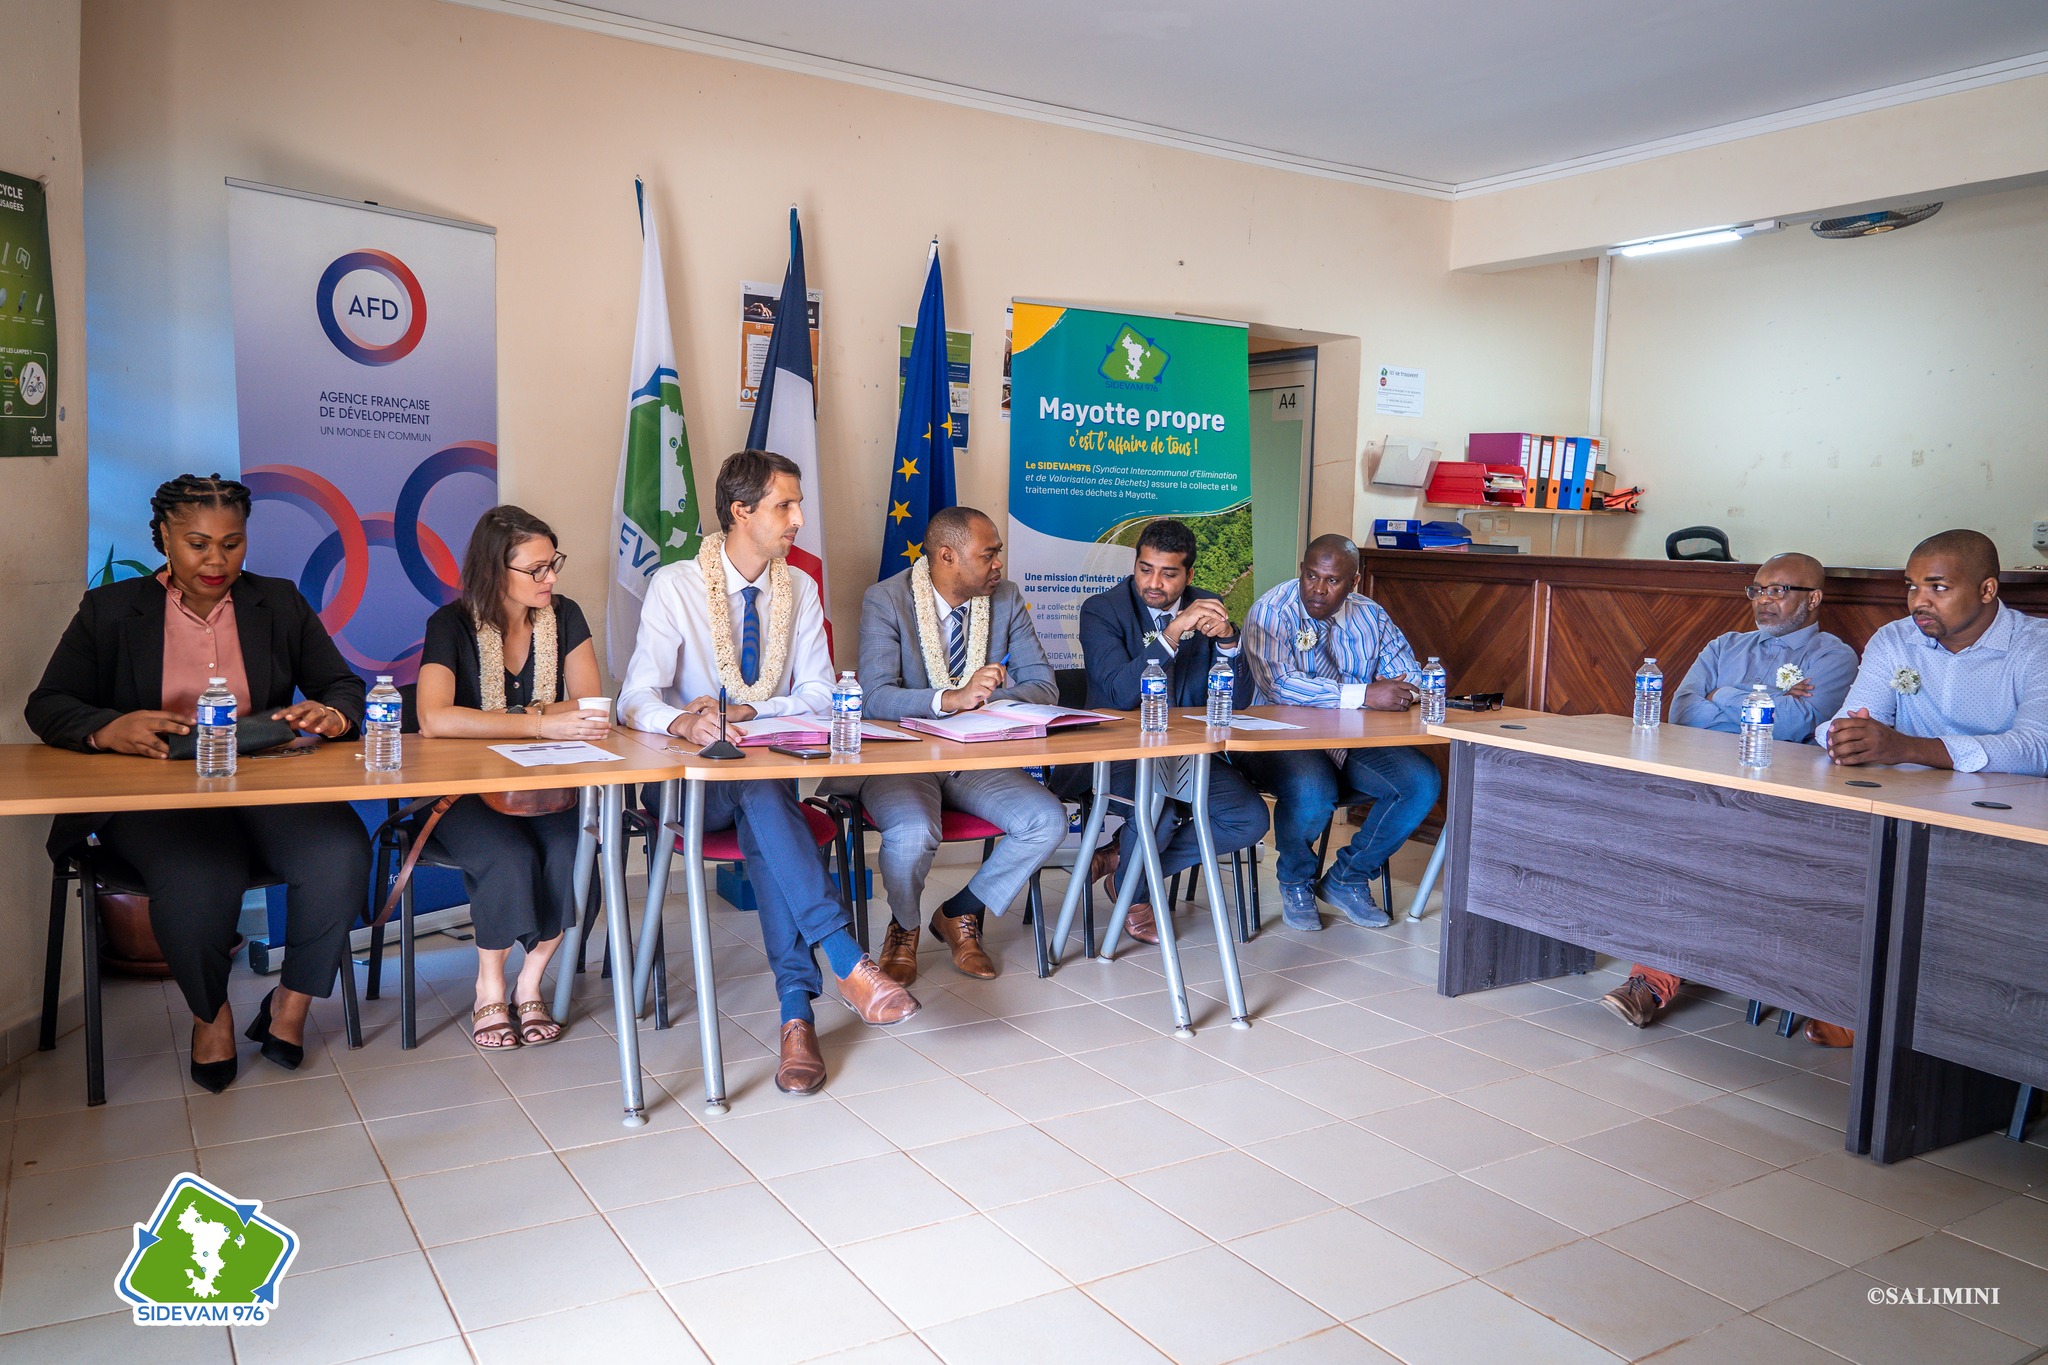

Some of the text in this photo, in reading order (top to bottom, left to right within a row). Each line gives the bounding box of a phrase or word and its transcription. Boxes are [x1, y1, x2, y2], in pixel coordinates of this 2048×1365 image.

[348, 295, 399, 320] AFD
[1105, 381, 1158, 393] SIDEVAM 976
[319, 390, 430, 411] AGENCE FRANÇAISE
[1278, 392, 1296, 410] A4
[320, 406, 430, 425] DE DÉVELOPPEMENT
[1039, 396, 1225, 434] Mayotte propre
[320, 426, 431, 442] UN MONDE EN COMMUN
[1151, 436, 1165, 455] de
[1165, 435, 1192, 457] tous
[1025, 461, 1238, 480] Le SIDEVAM976 (Syndicat Intercommunal d'Elimination
[1025, 474, 1238, 491] et de Valorisation des Déchets) assure la collecte et le
[1025, 485, 1158, 500] traitement des déchets à Mayotte.
[1024, 572, 1042, 581] Une
[1044, 573, 1078, 582] mission
[1079, 574, 1115, 583] d'intérêt
[1037, 584, 1070, 593] service
[1071, 585, 1081, 593] du
[1036, 603, 1046, 611] La
[1047, 603, 1075, 611] collecte
[1036, 631, 1075, 640] Traitement
[1047, 652, 1077, 660] SIDEVAM
